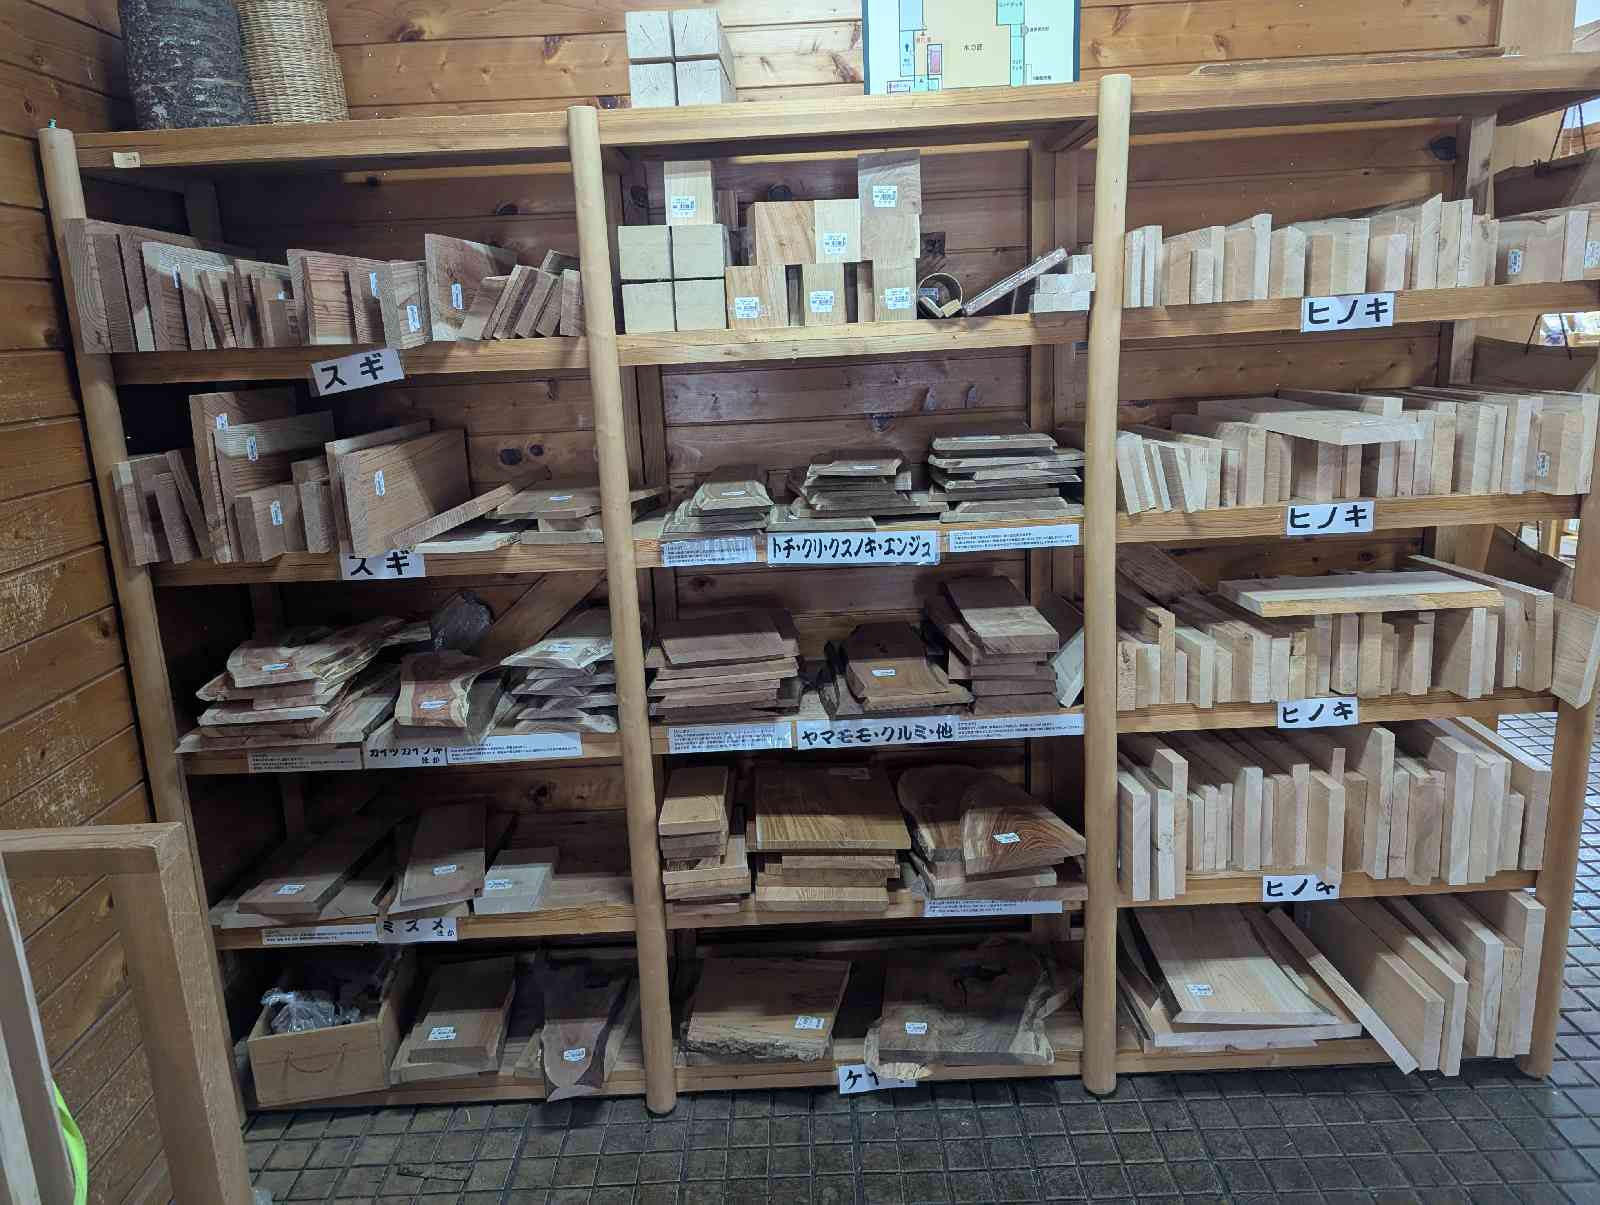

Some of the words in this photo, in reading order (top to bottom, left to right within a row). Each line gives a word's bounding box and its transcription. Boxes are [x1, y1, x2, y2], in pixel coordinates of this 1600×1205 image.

[1308, 297, 1388, 324] ヒノキ
[320, 352, 384, 389] スギ
[1290, 504, 1367, 529] ヒノキ
[348, 549, 410, 576] スギ
[1282, 701, 1353, 724] ヒノキ
[1265, 878, 1335, 897] ヒノキ
